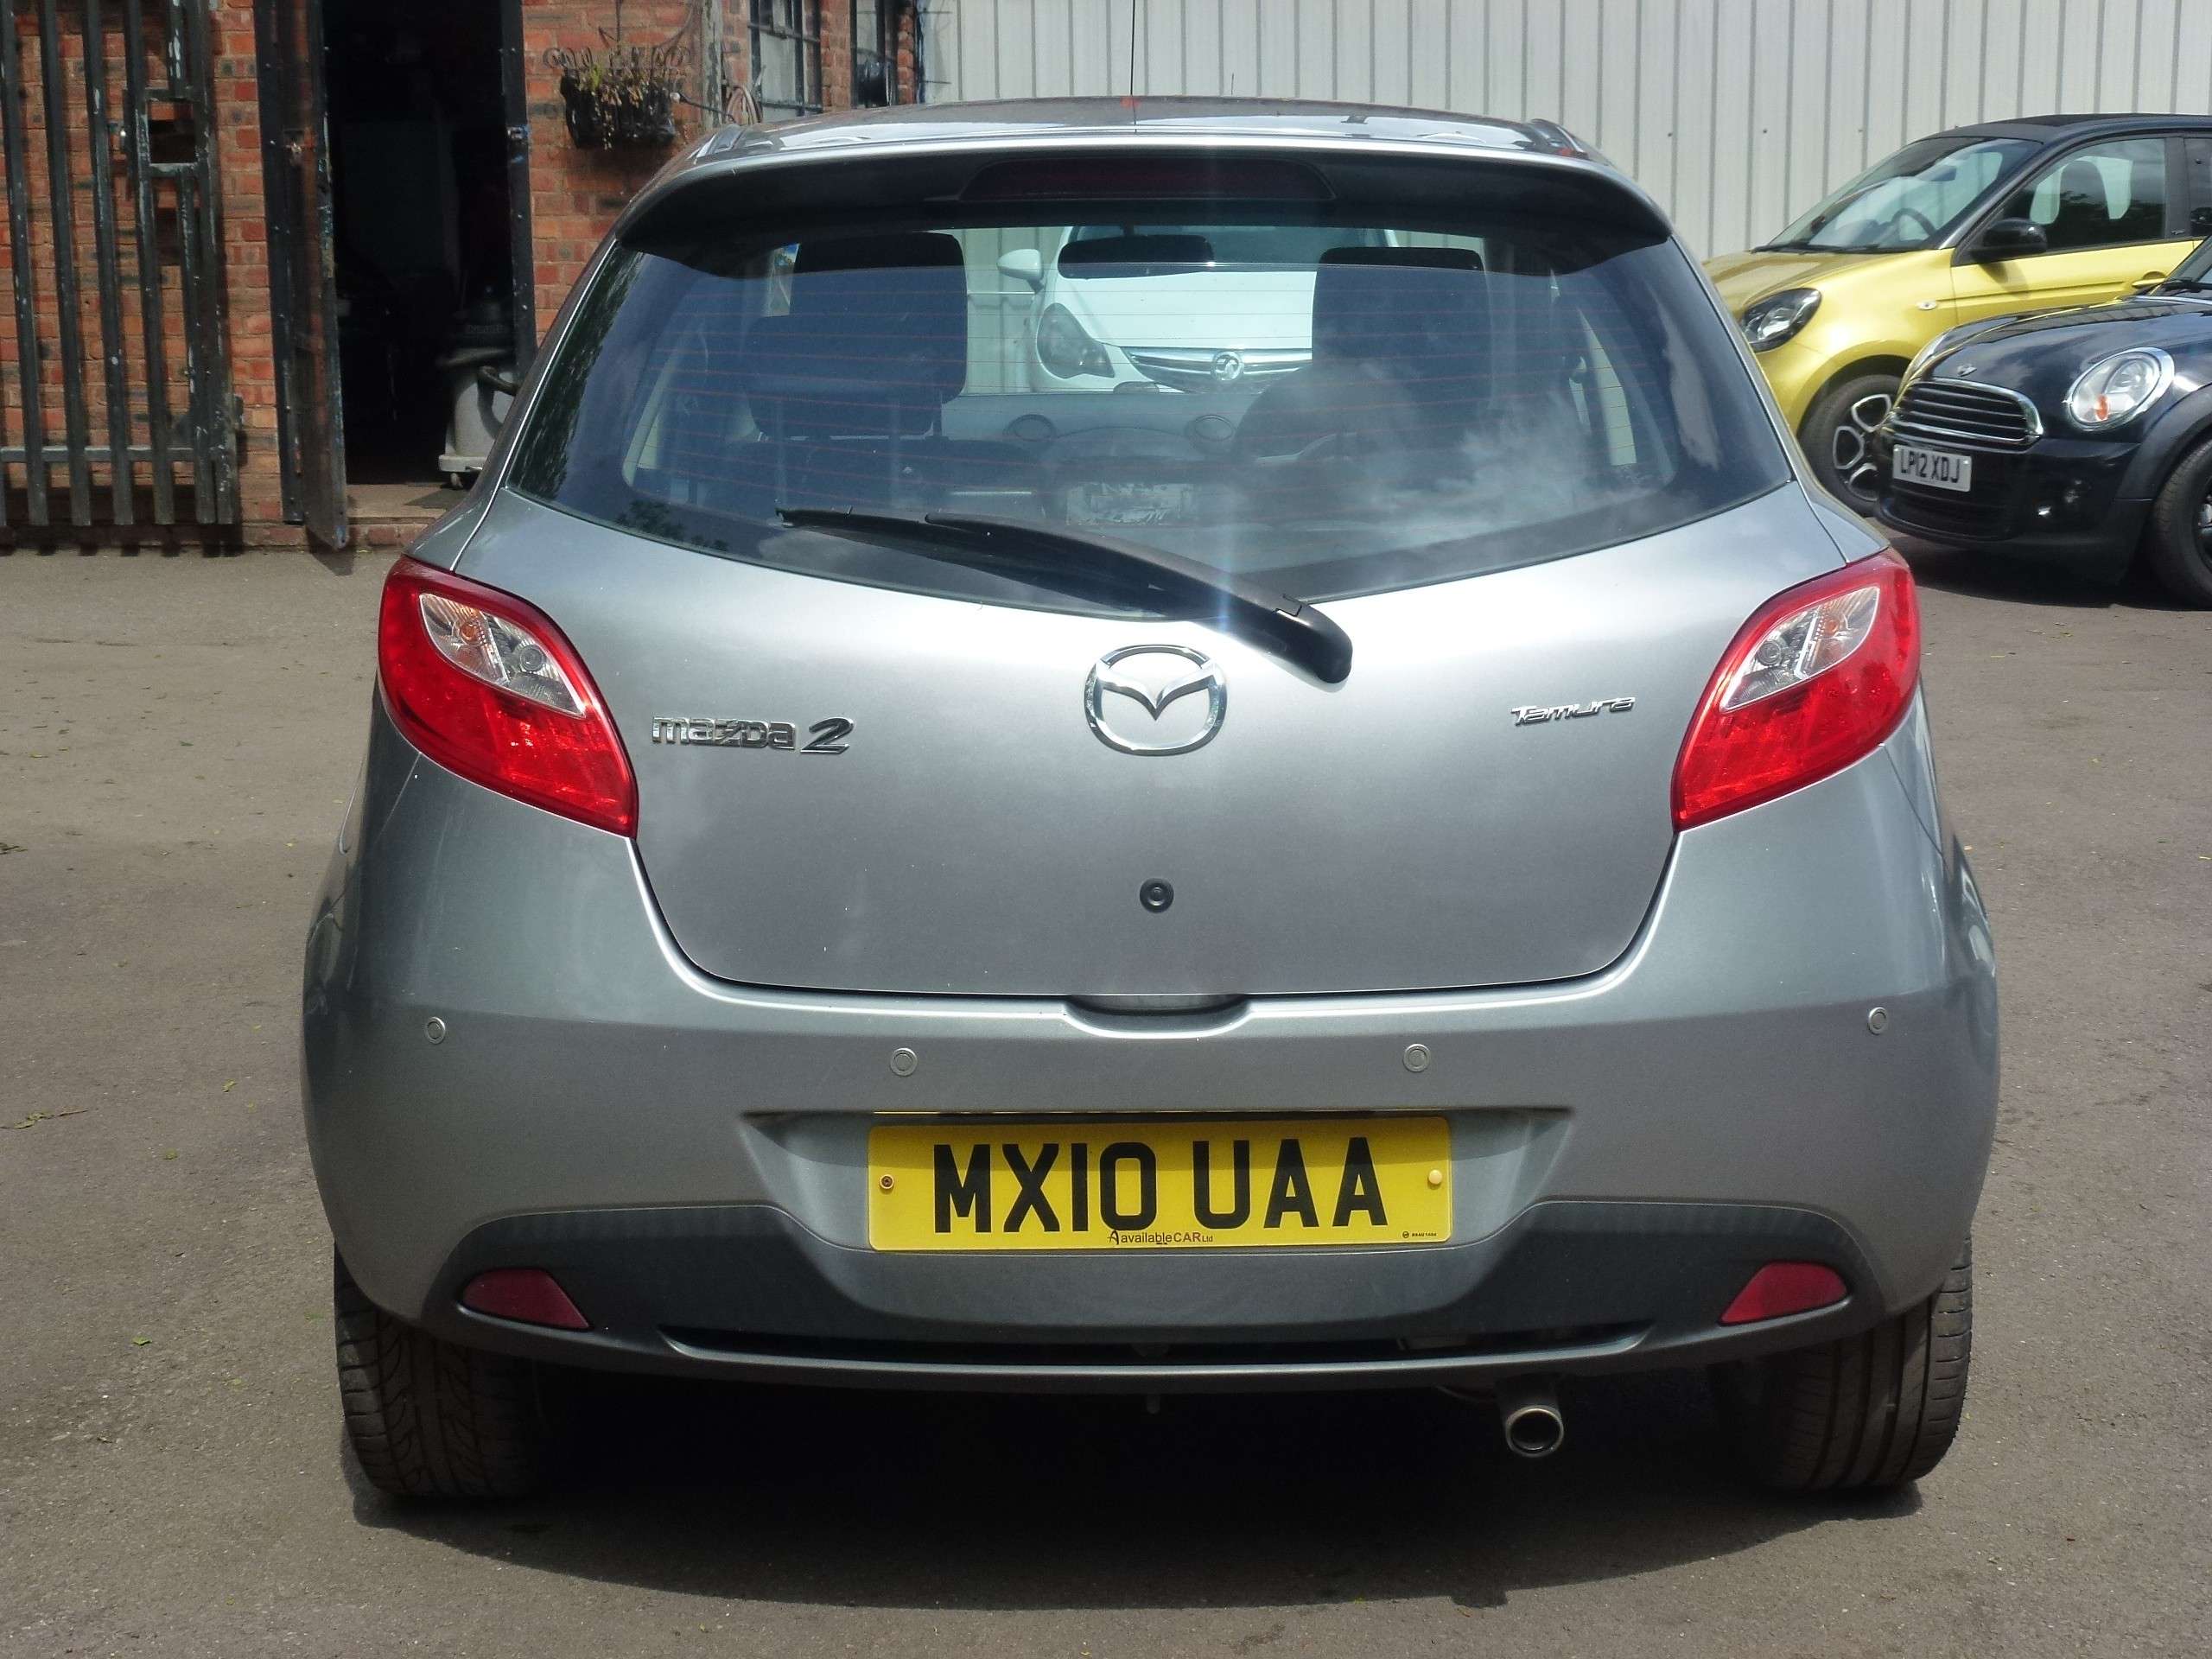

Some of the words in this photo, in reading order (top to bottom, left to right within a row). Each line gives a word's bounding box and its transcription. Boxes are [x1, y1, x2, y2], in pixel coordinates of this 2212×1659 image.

[1901, 449, 1928, 478] LP12
[1930, 454, 1961, 484] XDJ
[1512, 697, 1636, 726] Tamura
[652, 717, 795, 750] mazda
[800, 716, 855, 754] 2
[933, 1141, 1158, 1233] MX10
[1193, 1137, 1389, 1229] UAA
